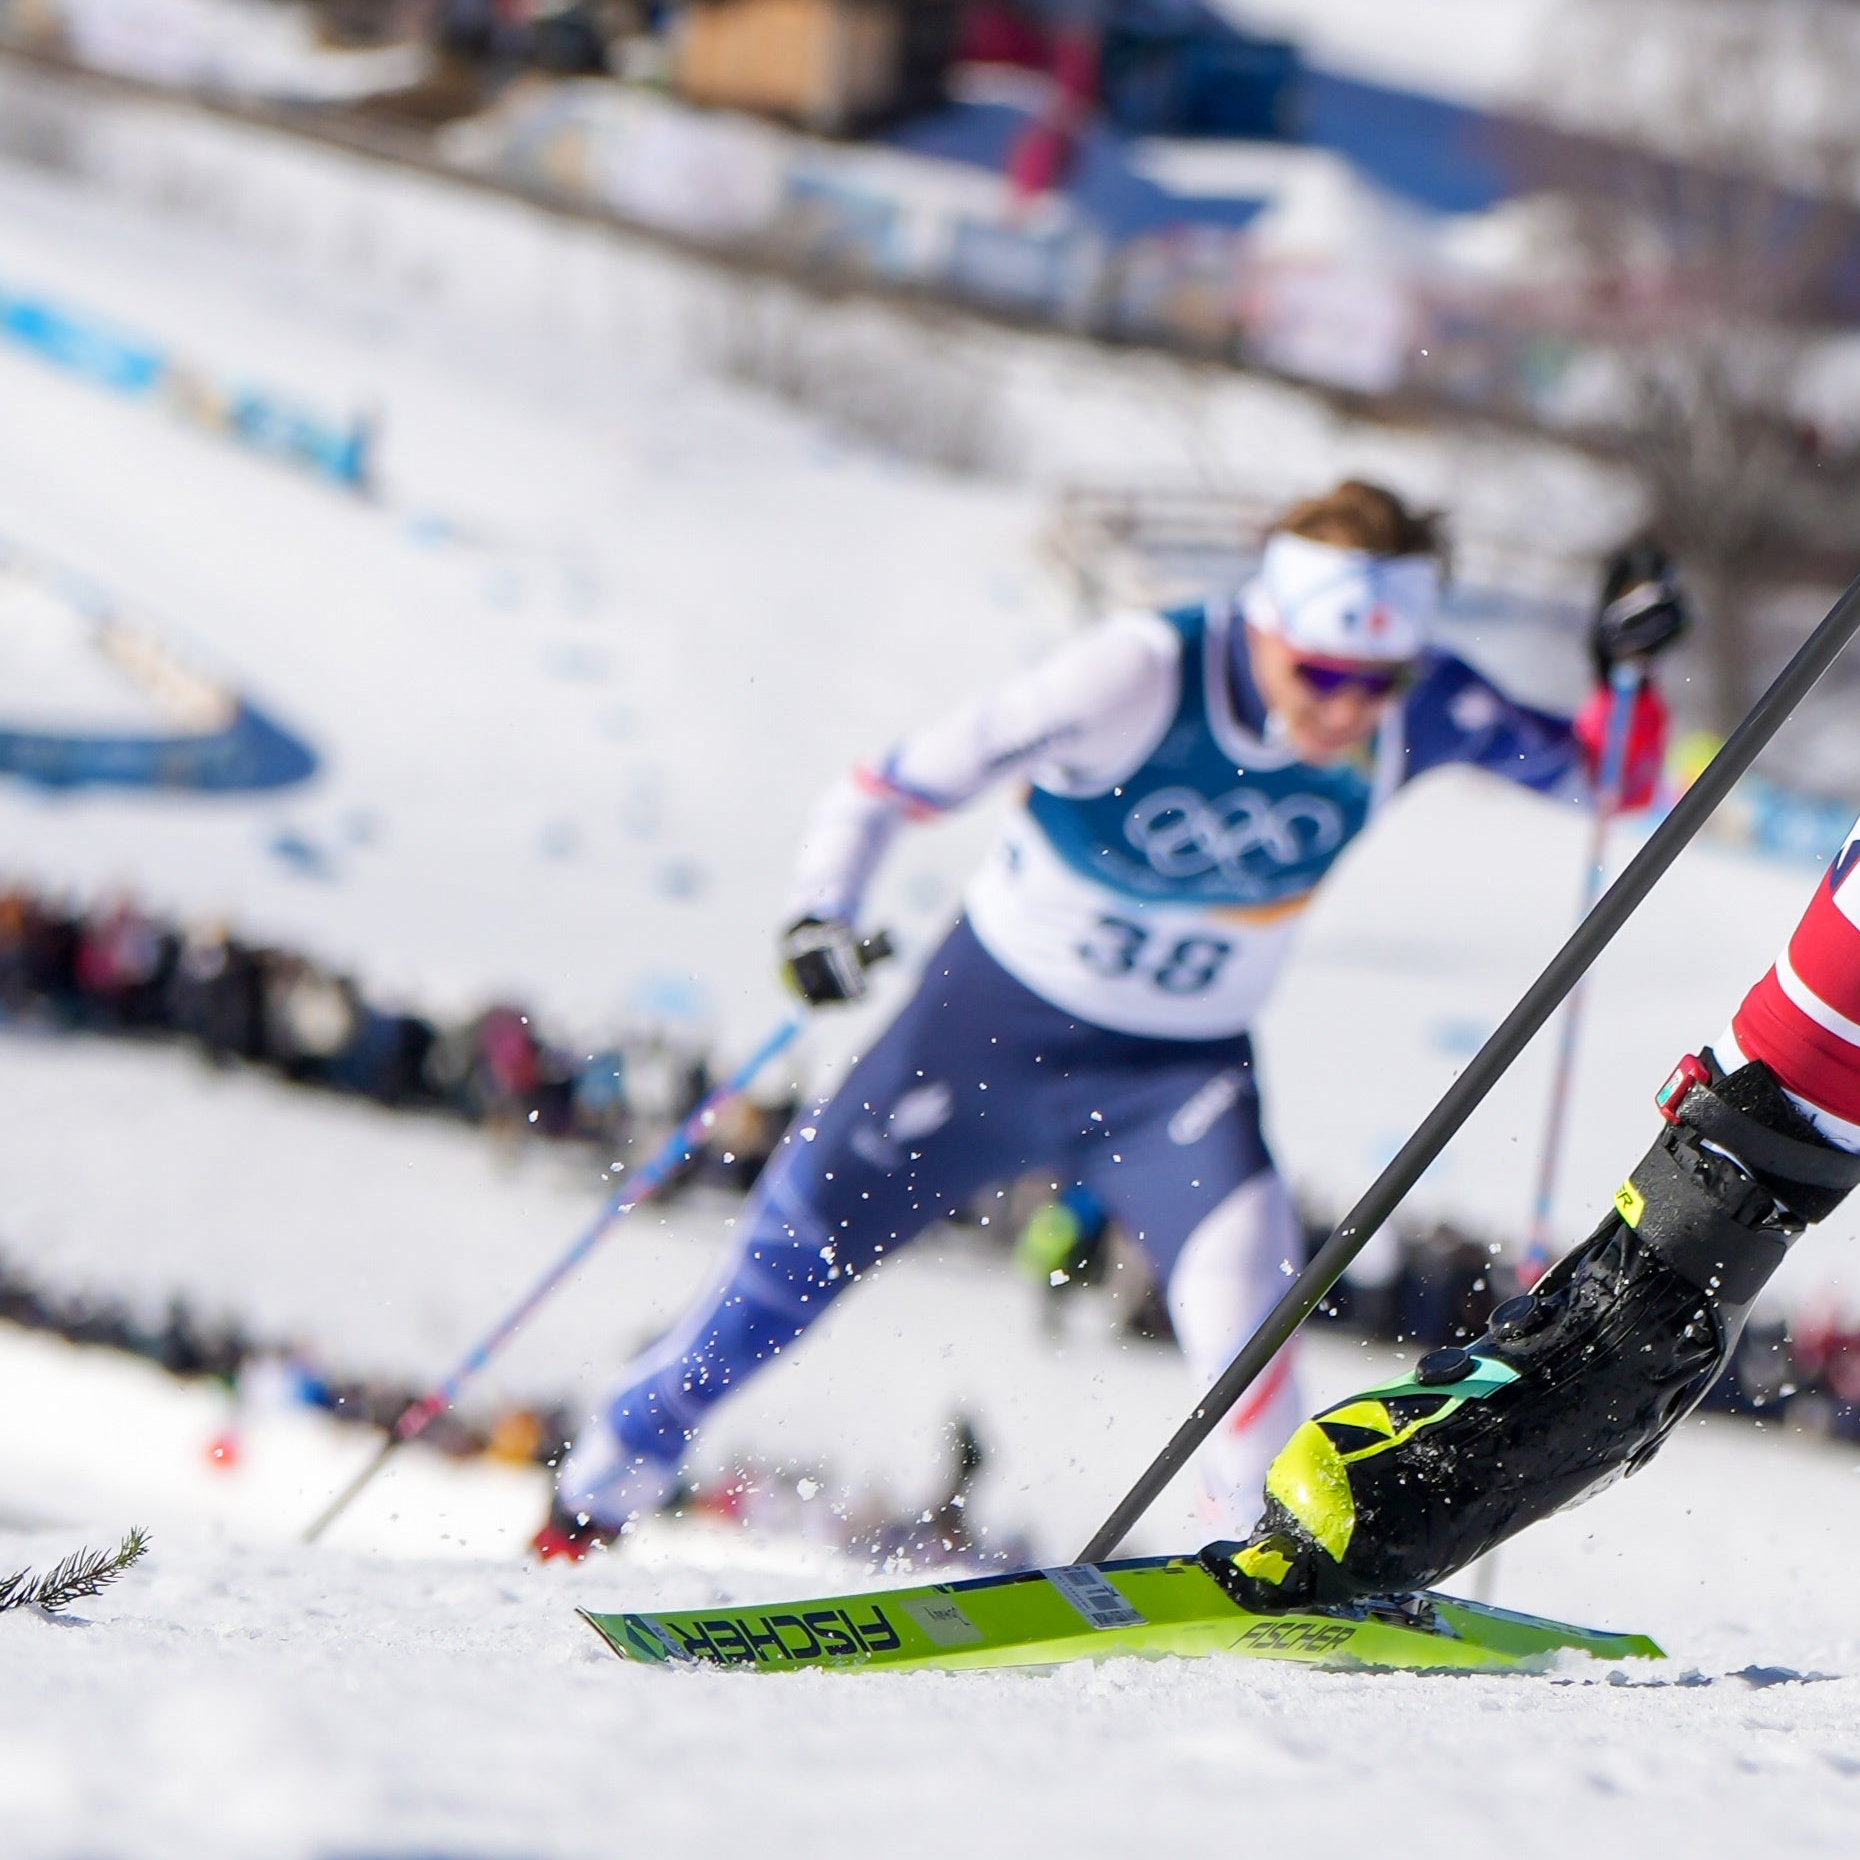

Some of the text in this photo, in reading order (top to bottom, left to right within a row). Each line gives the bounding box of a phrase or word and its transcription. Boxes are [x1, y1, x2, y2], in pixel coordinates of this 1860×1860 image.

[1075, 912, 1232, 995] 38
[666, 1604, 901, 1664] FISCHER
[1227, 1621, 1357, 1653] FISCHER
